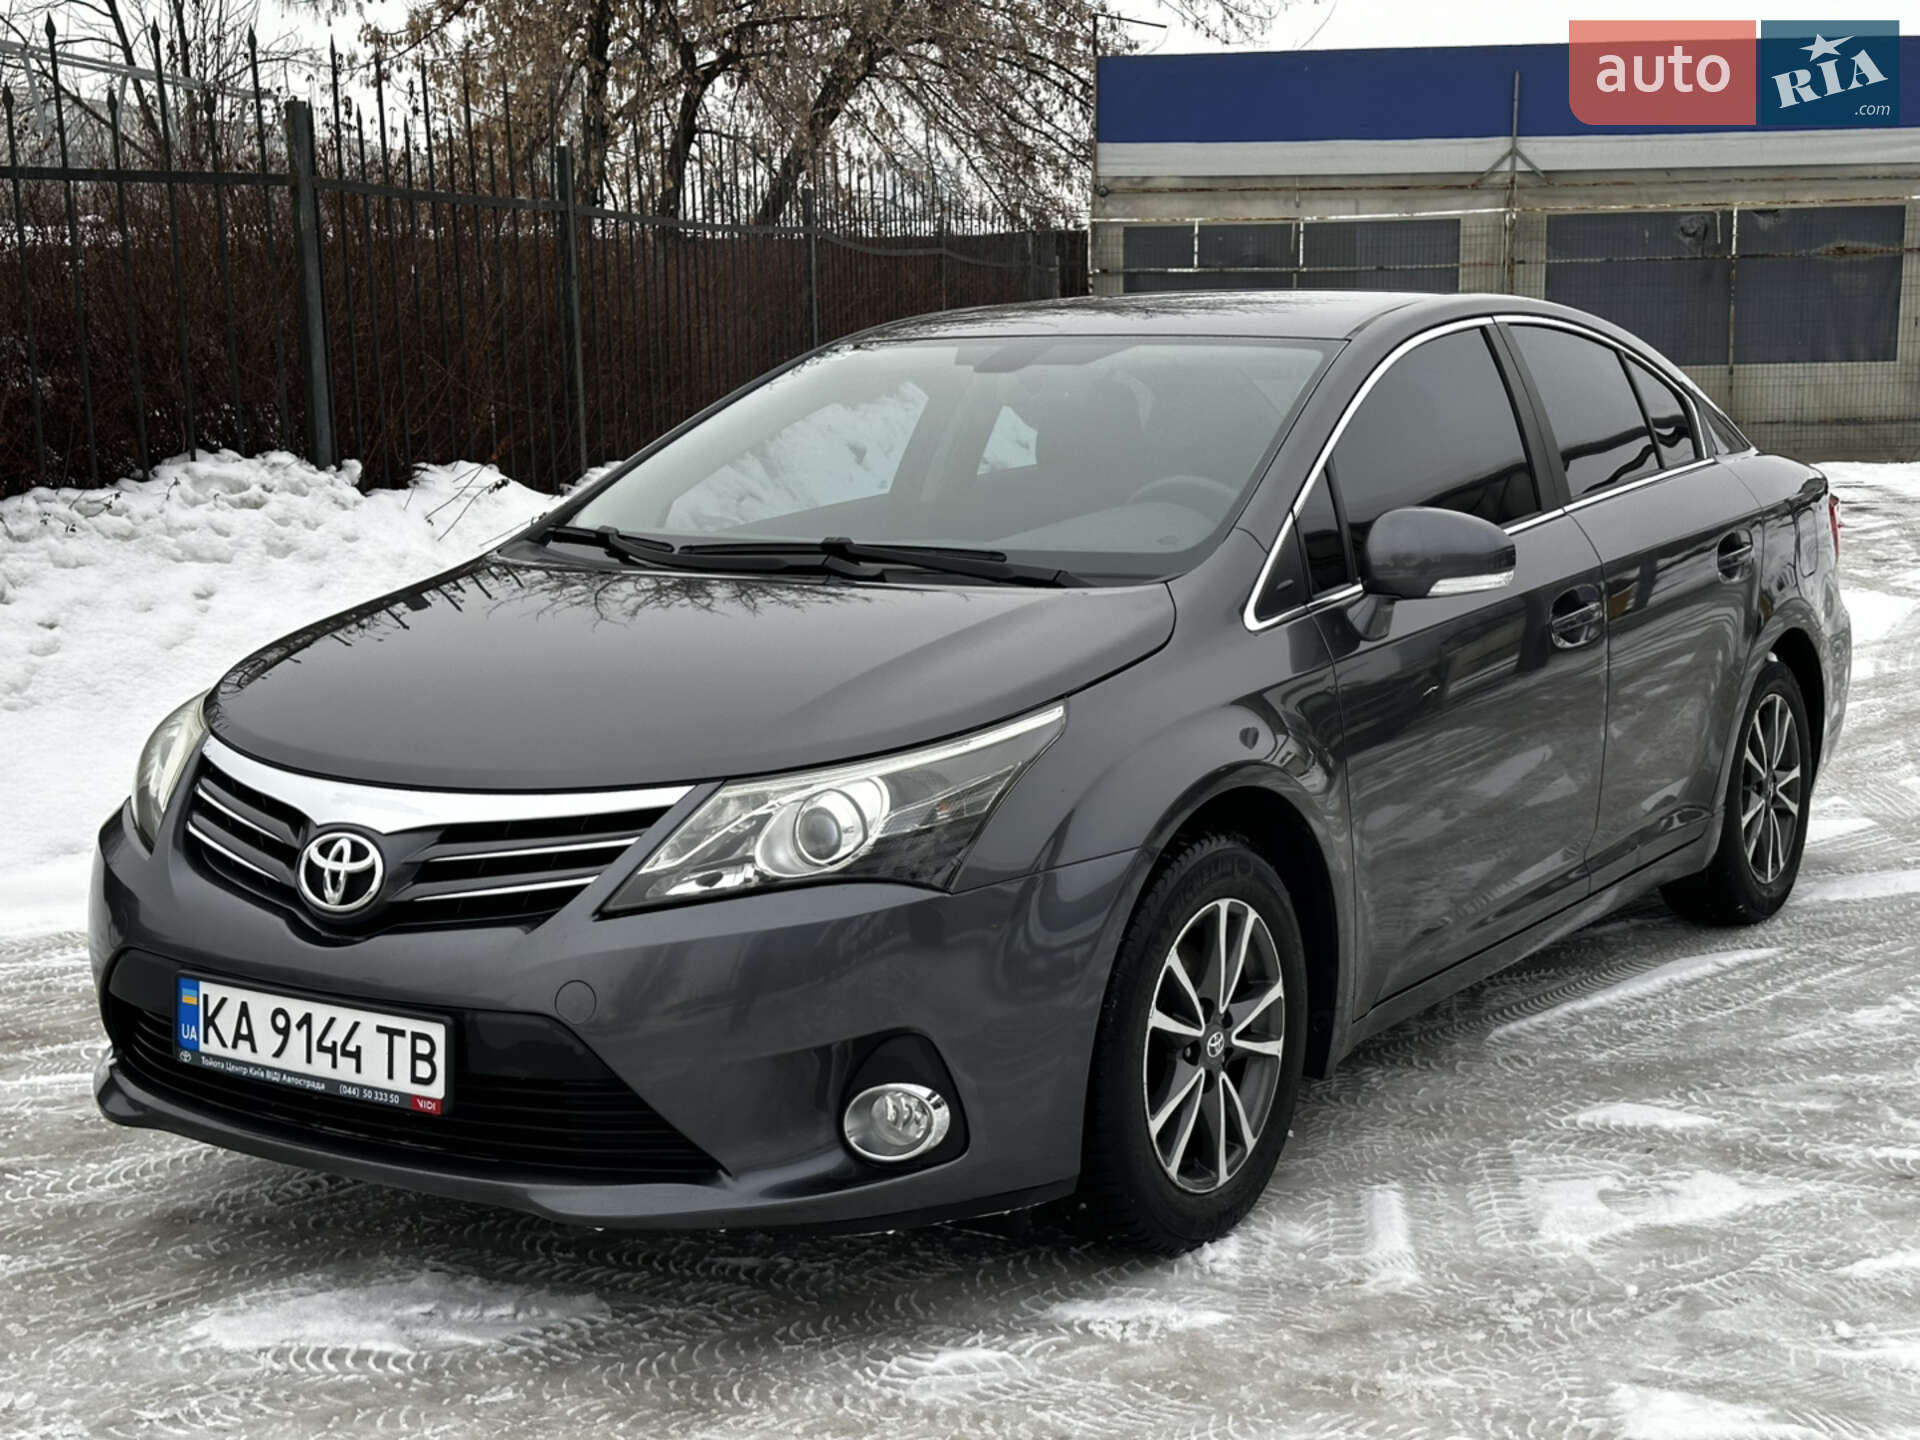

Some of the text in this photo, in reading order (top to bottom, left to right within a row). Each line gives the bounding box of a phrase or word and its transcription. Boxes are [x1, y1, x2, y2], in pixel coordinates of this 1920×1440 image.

[182, 1023, 197, 1041] UA
[202, 993, 438, 1087] KA 9144 TB
[201, 1056, 224, 1068] Тойота
[226, 1062, 248, 1075] Центр
[282, 1074, 325, 1090] Автострада
[339, 1083, 358, 1097] (044)
[417, 1098, 436, 1111] VIDI
